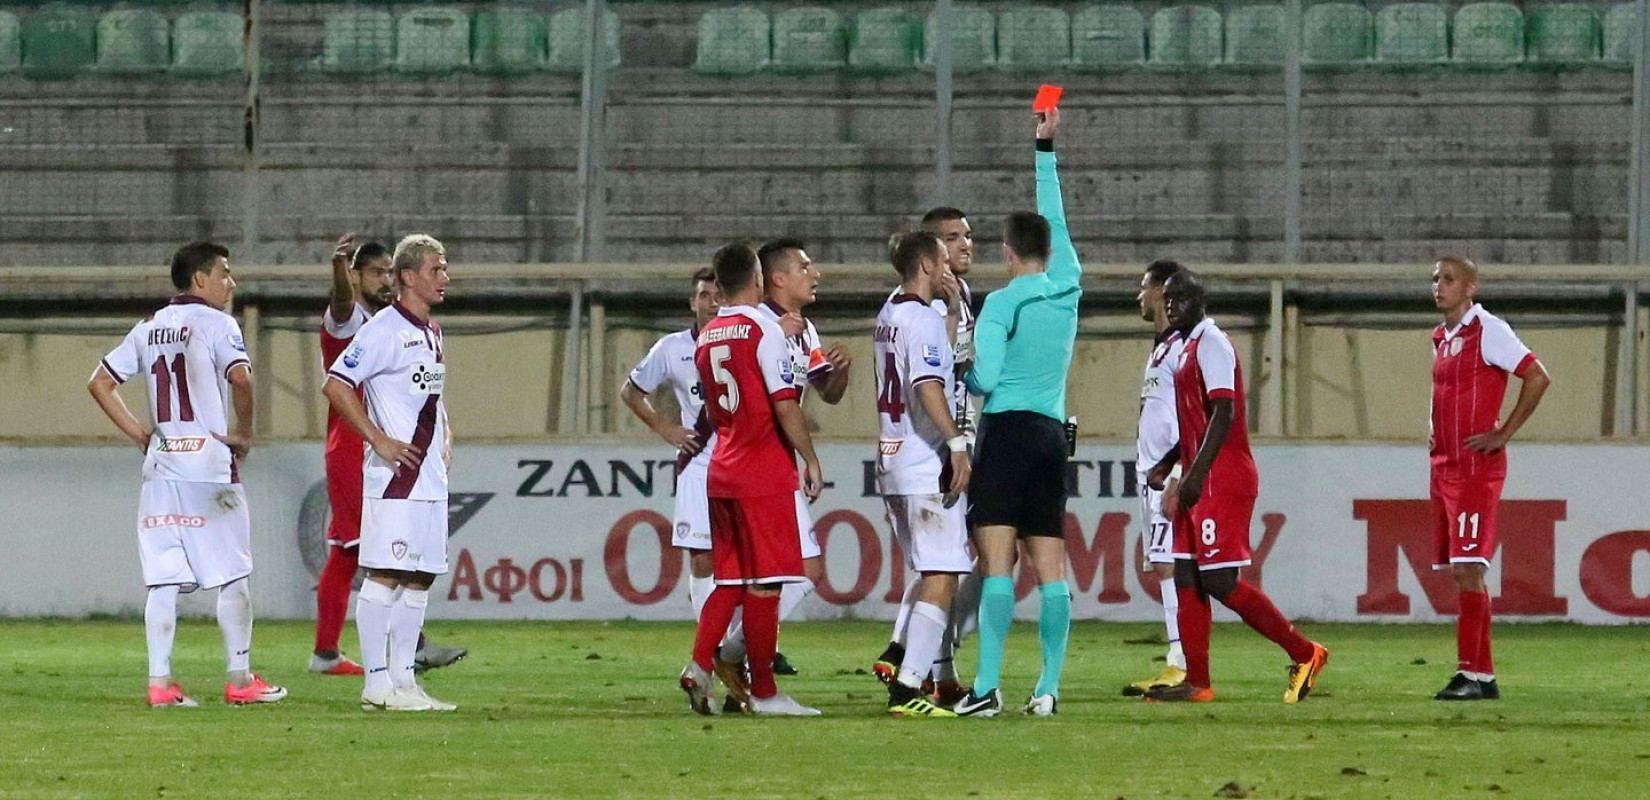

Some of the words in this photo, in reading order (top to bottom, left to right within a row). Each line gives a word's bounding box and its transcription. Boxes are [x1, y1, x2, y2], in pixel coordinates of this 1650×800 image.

[151, 352, 195, 423] 11
[709, 344, 740, 414] 5
[877, 352, 906, 423] 4
[515, 460, 678, 498] ΖΑΝΤ
[1201, 518, 1217, 546] 8
[1457, 511, 1480, 539] 11
[447, 548, 584, 604] ΑΦΟΙ
